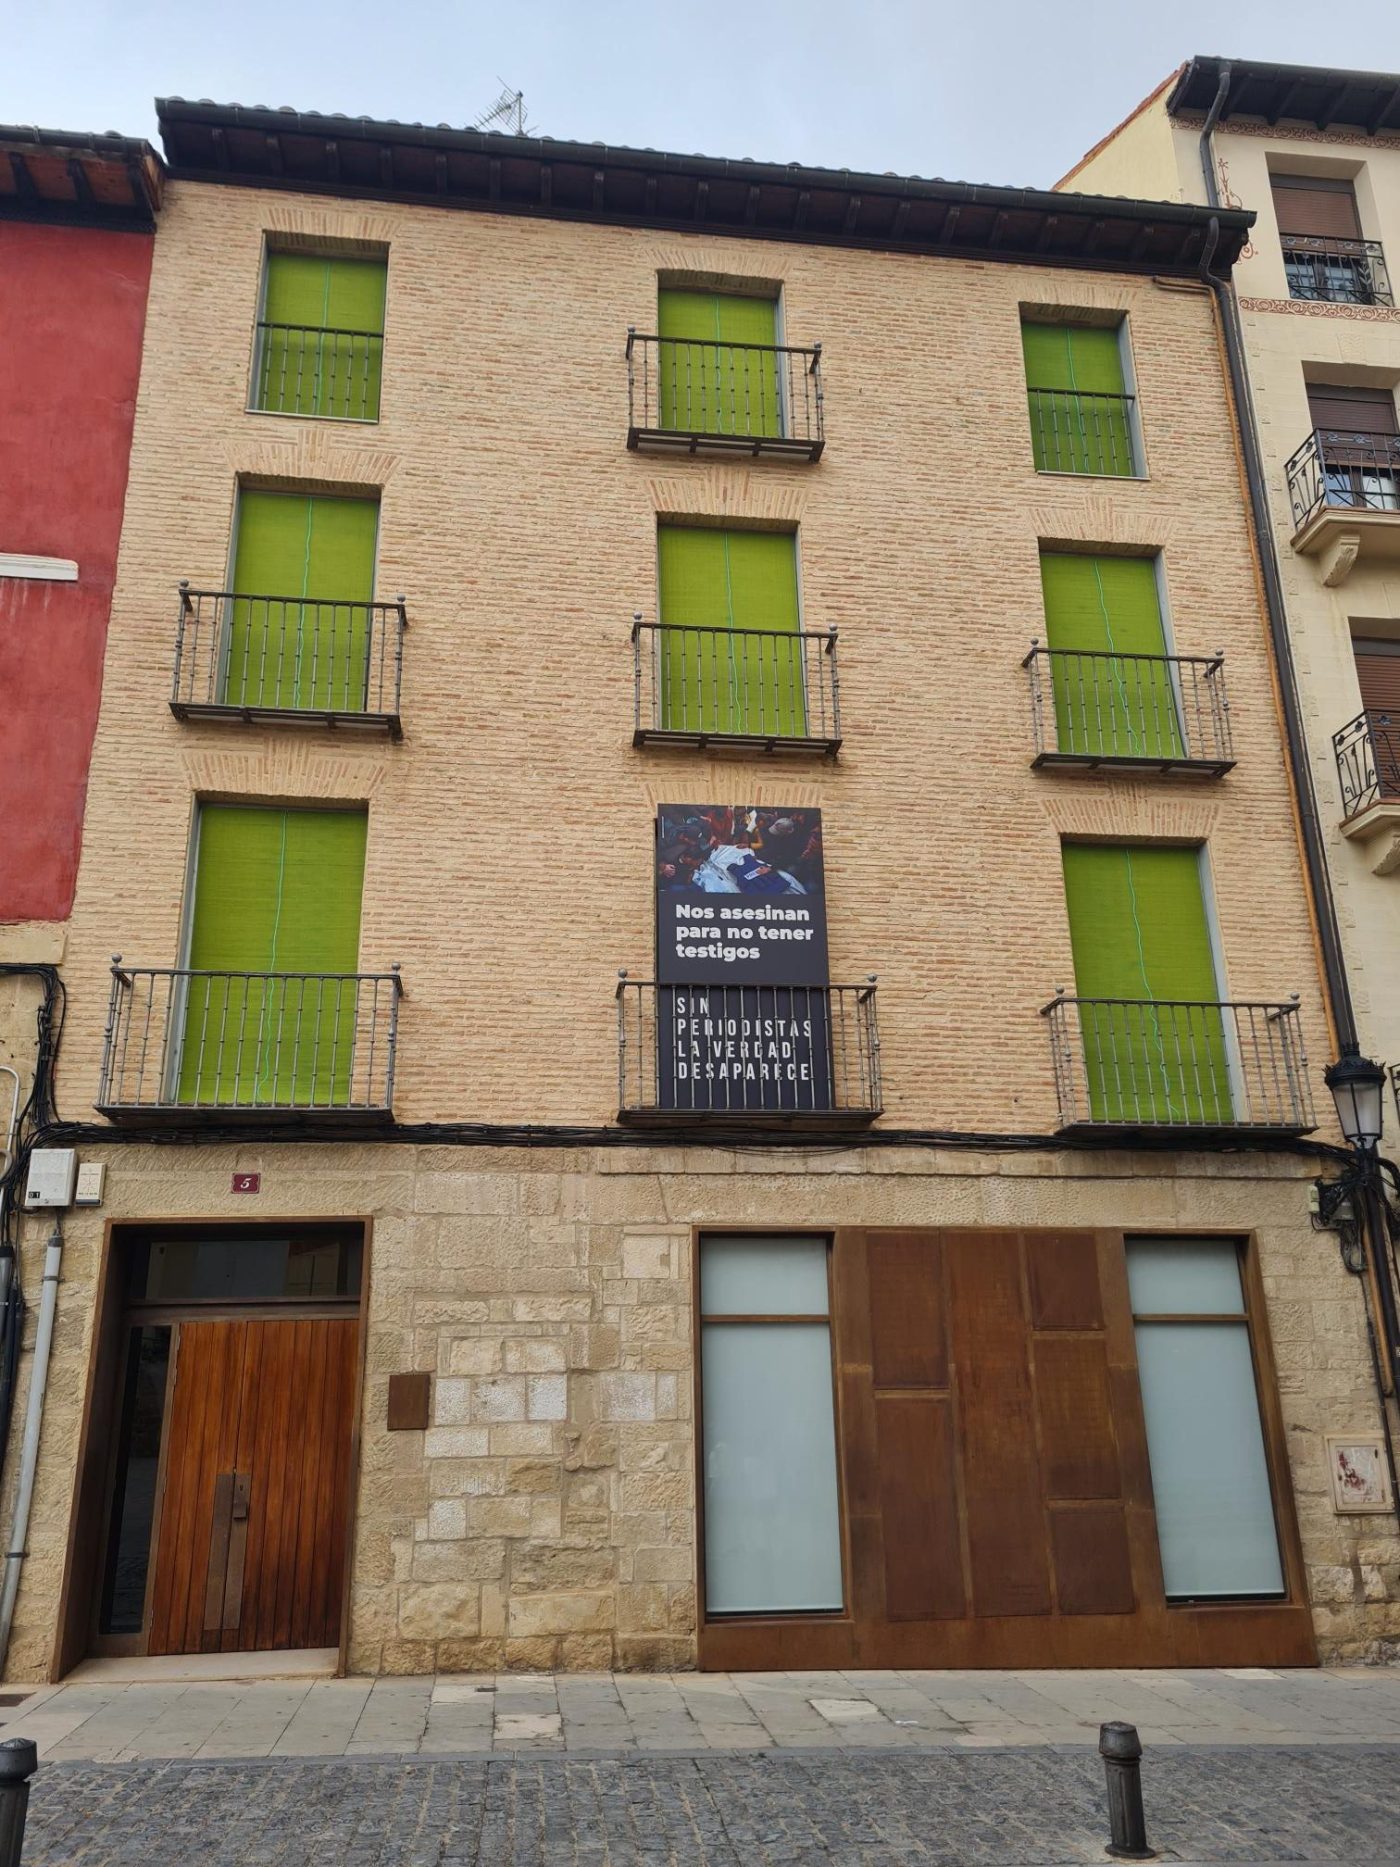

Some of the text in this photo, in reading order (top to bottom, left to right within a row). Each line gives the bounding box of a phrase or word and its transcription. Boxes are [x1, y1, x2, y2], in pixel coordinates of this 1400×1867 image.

[675, 904, 810, 921] Nos asesinan
[676, 925, 814, 941] para no tener
[675, 943, 761, 962] testigos
[677, 997, 709, 1014] SIN
[677, 1018, 812, 1037] PERIODISTAS
[678, 1040, 792, 1058] LA VERDAD
[678, 1062, 809, 1081] DESAPARECE
[240, 1177, 251, 1189] 5
